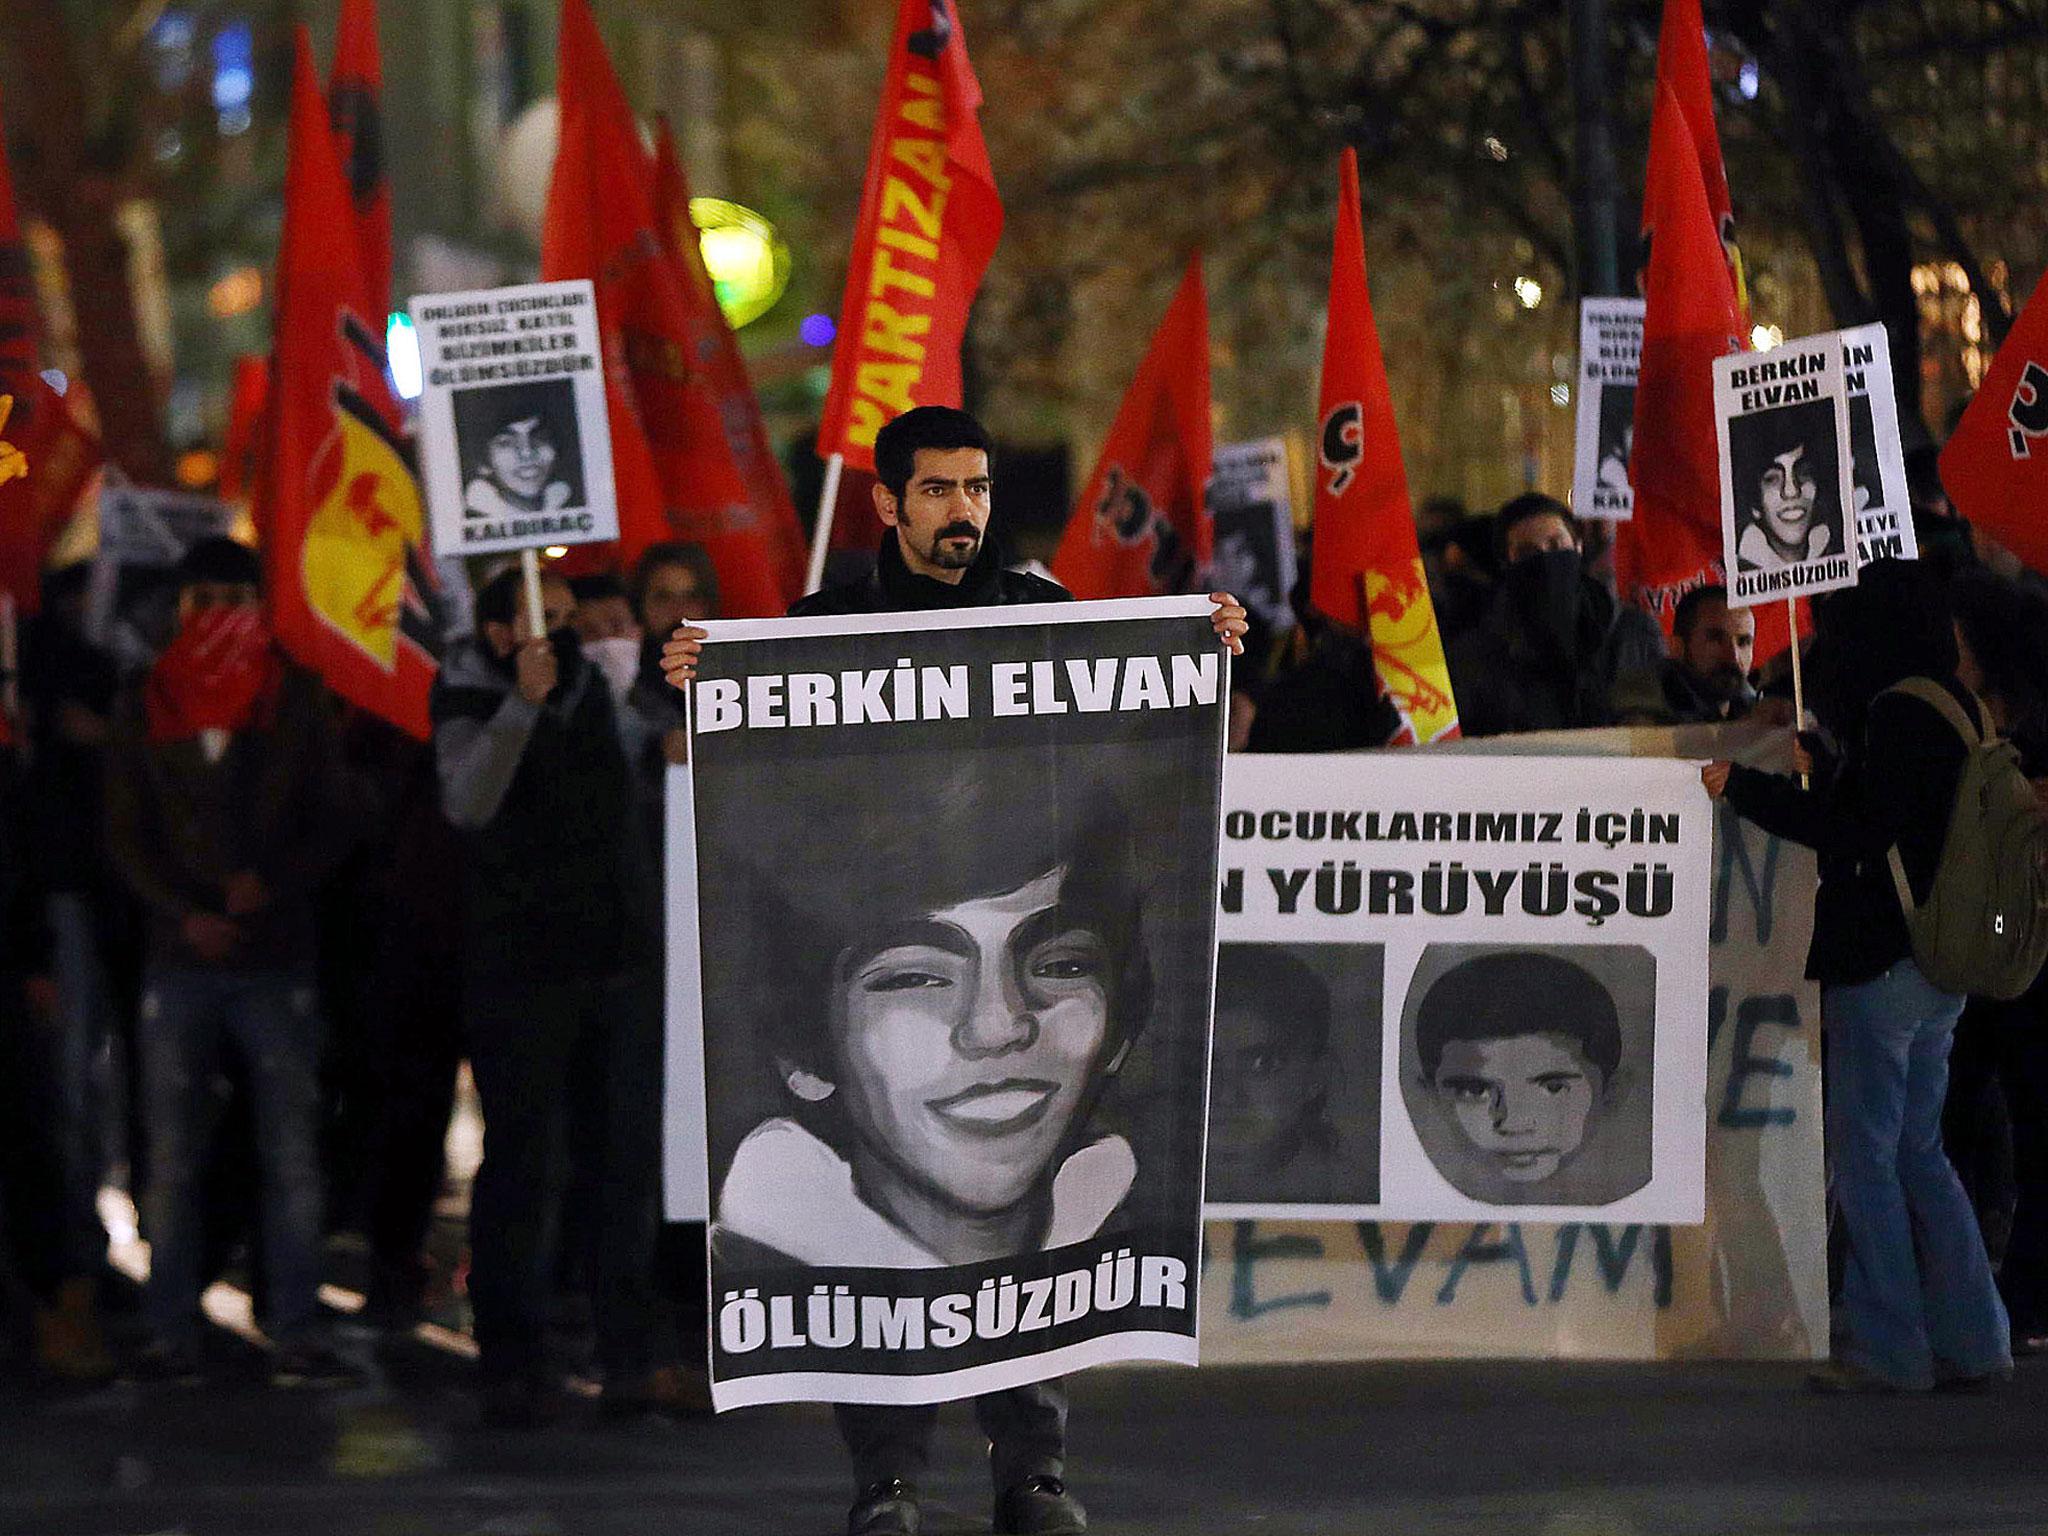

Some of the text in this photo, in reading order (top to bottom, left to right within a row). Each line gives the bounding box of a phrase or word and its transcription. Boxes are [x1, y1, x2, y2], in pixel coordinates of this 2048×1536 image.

[1731, 352, 1826, 389] BERKİN
[1741, 379, 1819, 411] ELVAN
[1736, 559, 1849, 597] ÖLÜMSÜZDÜR
[696, 652, 1218, 734] BERKİN ELVAN
[1575, 807, 1680, 849] İÇİN
[1267, 860, 1674, 926] YÜRÜYÜŞÜ
[720, 1248, 1188, 1353] ÖLÜMSÜZDÜR
